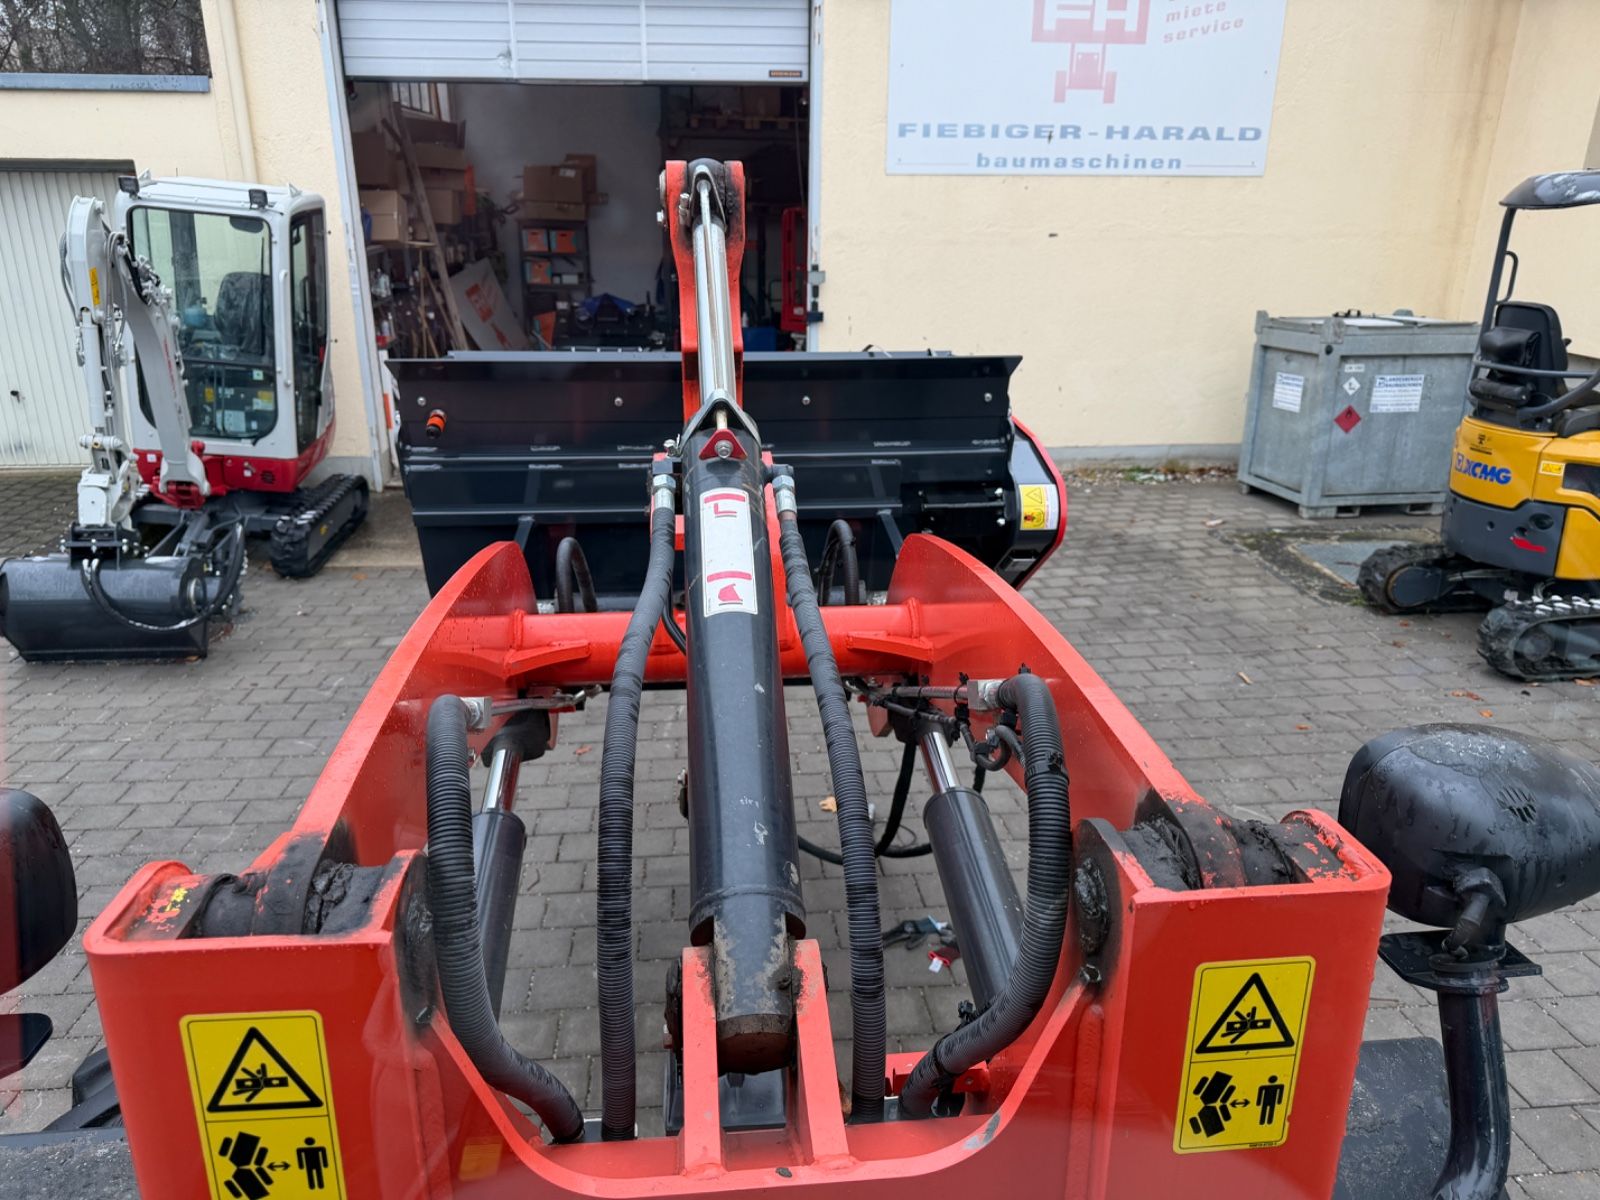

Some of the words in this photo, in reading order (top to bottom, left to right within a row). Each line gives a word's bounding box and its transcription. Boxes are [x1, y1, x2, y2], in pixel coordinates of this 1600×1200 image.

[1165, 2, 1227, 23] miete
[1162, 17, 1245, 44] service
[976, 152, 1182, 169] baumaschinen
[1464, 458, 1512, 485] XCMG
